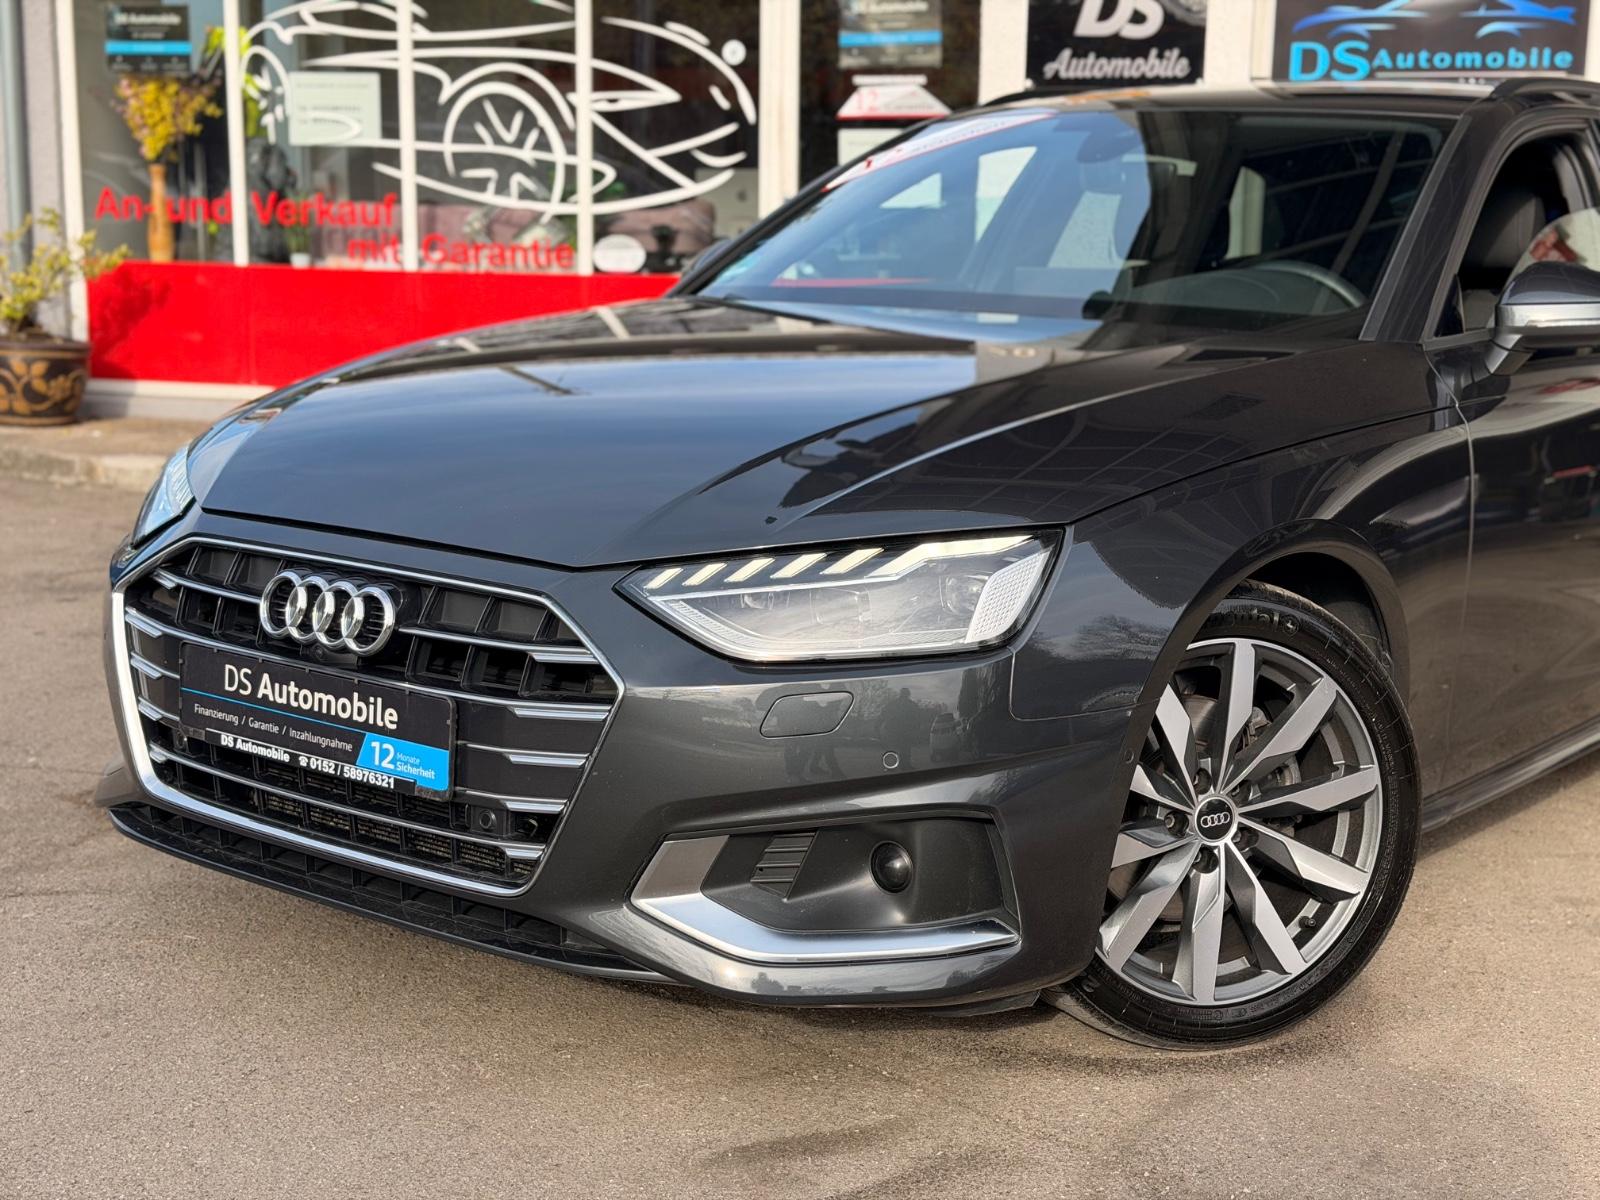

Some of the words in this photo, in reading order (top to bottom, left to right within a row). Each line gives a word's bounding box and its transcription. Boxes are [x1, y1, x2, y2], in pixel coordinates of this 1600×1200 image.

[1073, 0, 1165, 40] DS
[1043, 47, 1191, 80] Automobile
[1288, 40, 1371, 82] DS
[1371, 47, 1574, 70] Automobile
[167, 191, 233, 224] und
[252, 190, 398, 226] Verkauf
[347, 233, 402, 263] mit
[422, 232, 575, 269] Garantie
[224, 664, 252, 696] DS
[257, 672, 399, 730] Automobile
[194, 703, 239, 726] Finanzierung
[248, 717, 280, 734] Garantie
[289, 727, 353, 752] Inzahlungnahme
[220, 734, 234, 747] DS
[236, 739, 290, 762] Automobile
[309, 757, 335, 774] 0152
[343, 767, 395, 789] 58976321
[371, 741, 395, 769] 12
[396, 752, 420, 765] Monate
[396, 762, 435, 779] Sicherheit
